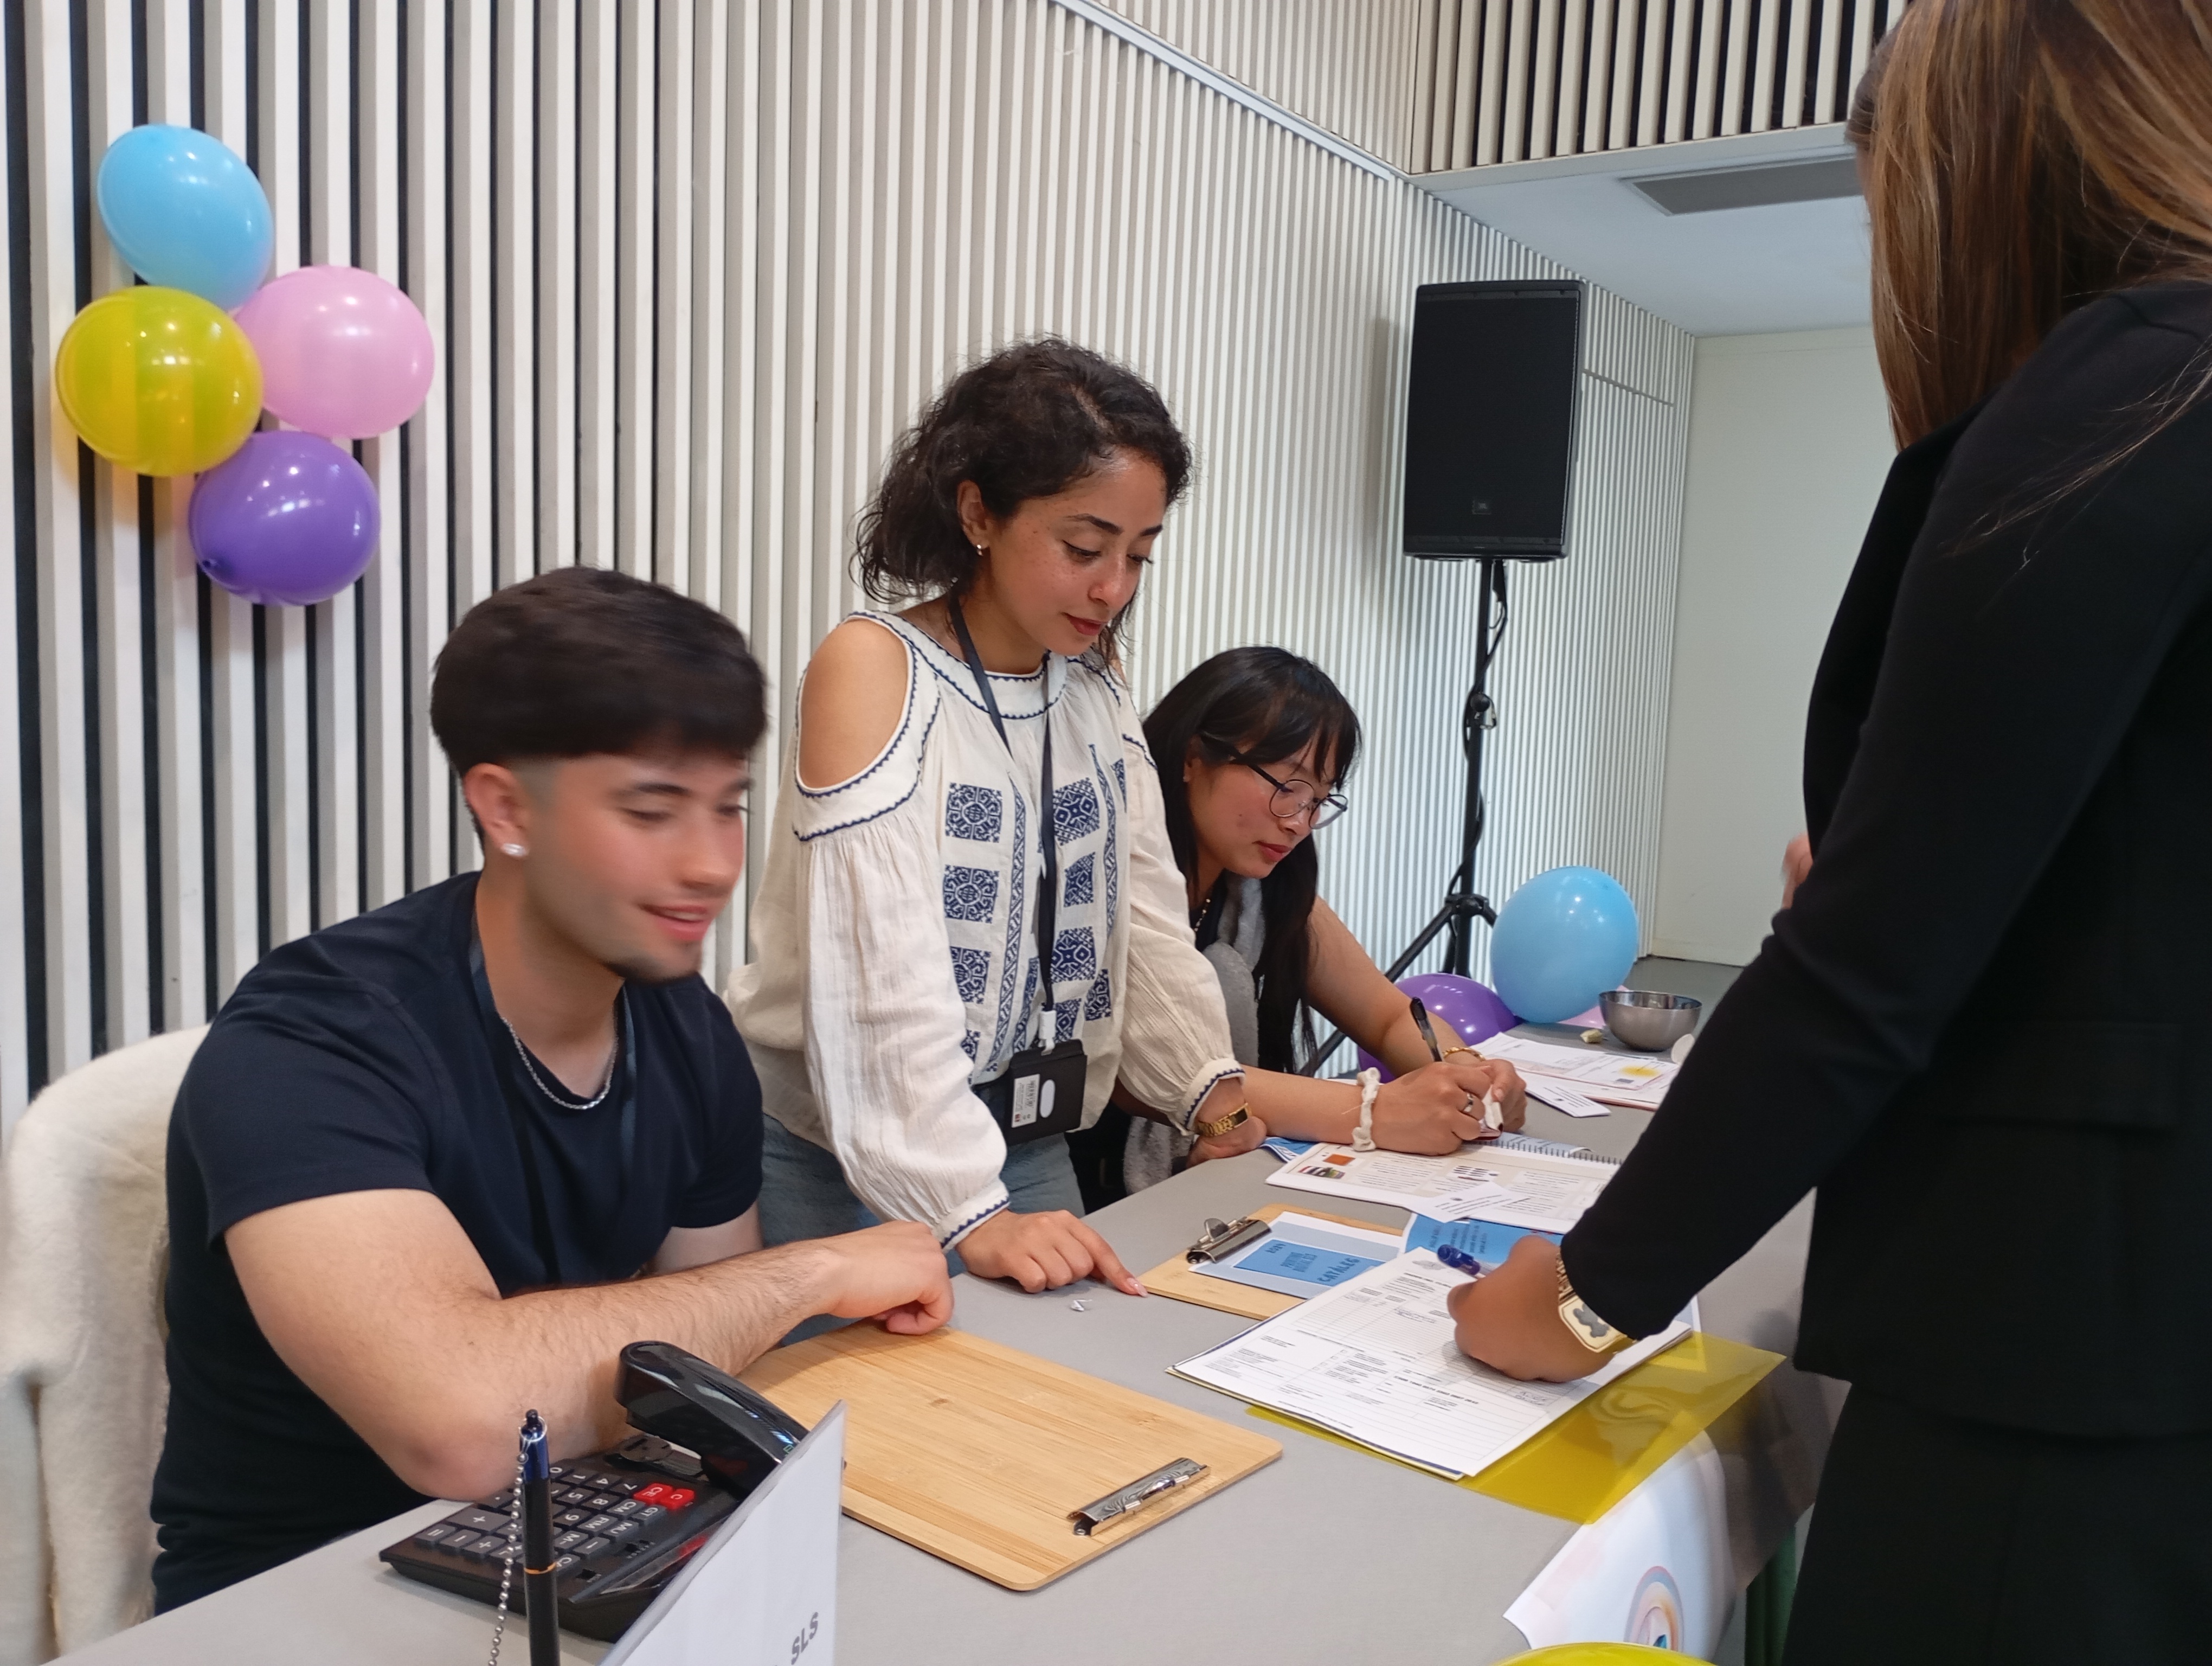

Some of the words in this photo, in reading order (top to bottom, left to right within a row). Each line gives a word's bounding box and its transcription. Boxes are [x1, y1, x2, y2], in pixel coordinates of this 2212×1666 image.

[642, 1487, 663, 1497] CE
[614, 1502, 637, 1513] CM
[641, 1507, 658, 1517] GT
[585, 1517, 610, 1529] RM
[610, 1522, 633, 1534] MU
[790, 1612, 819, 1665] SLS
